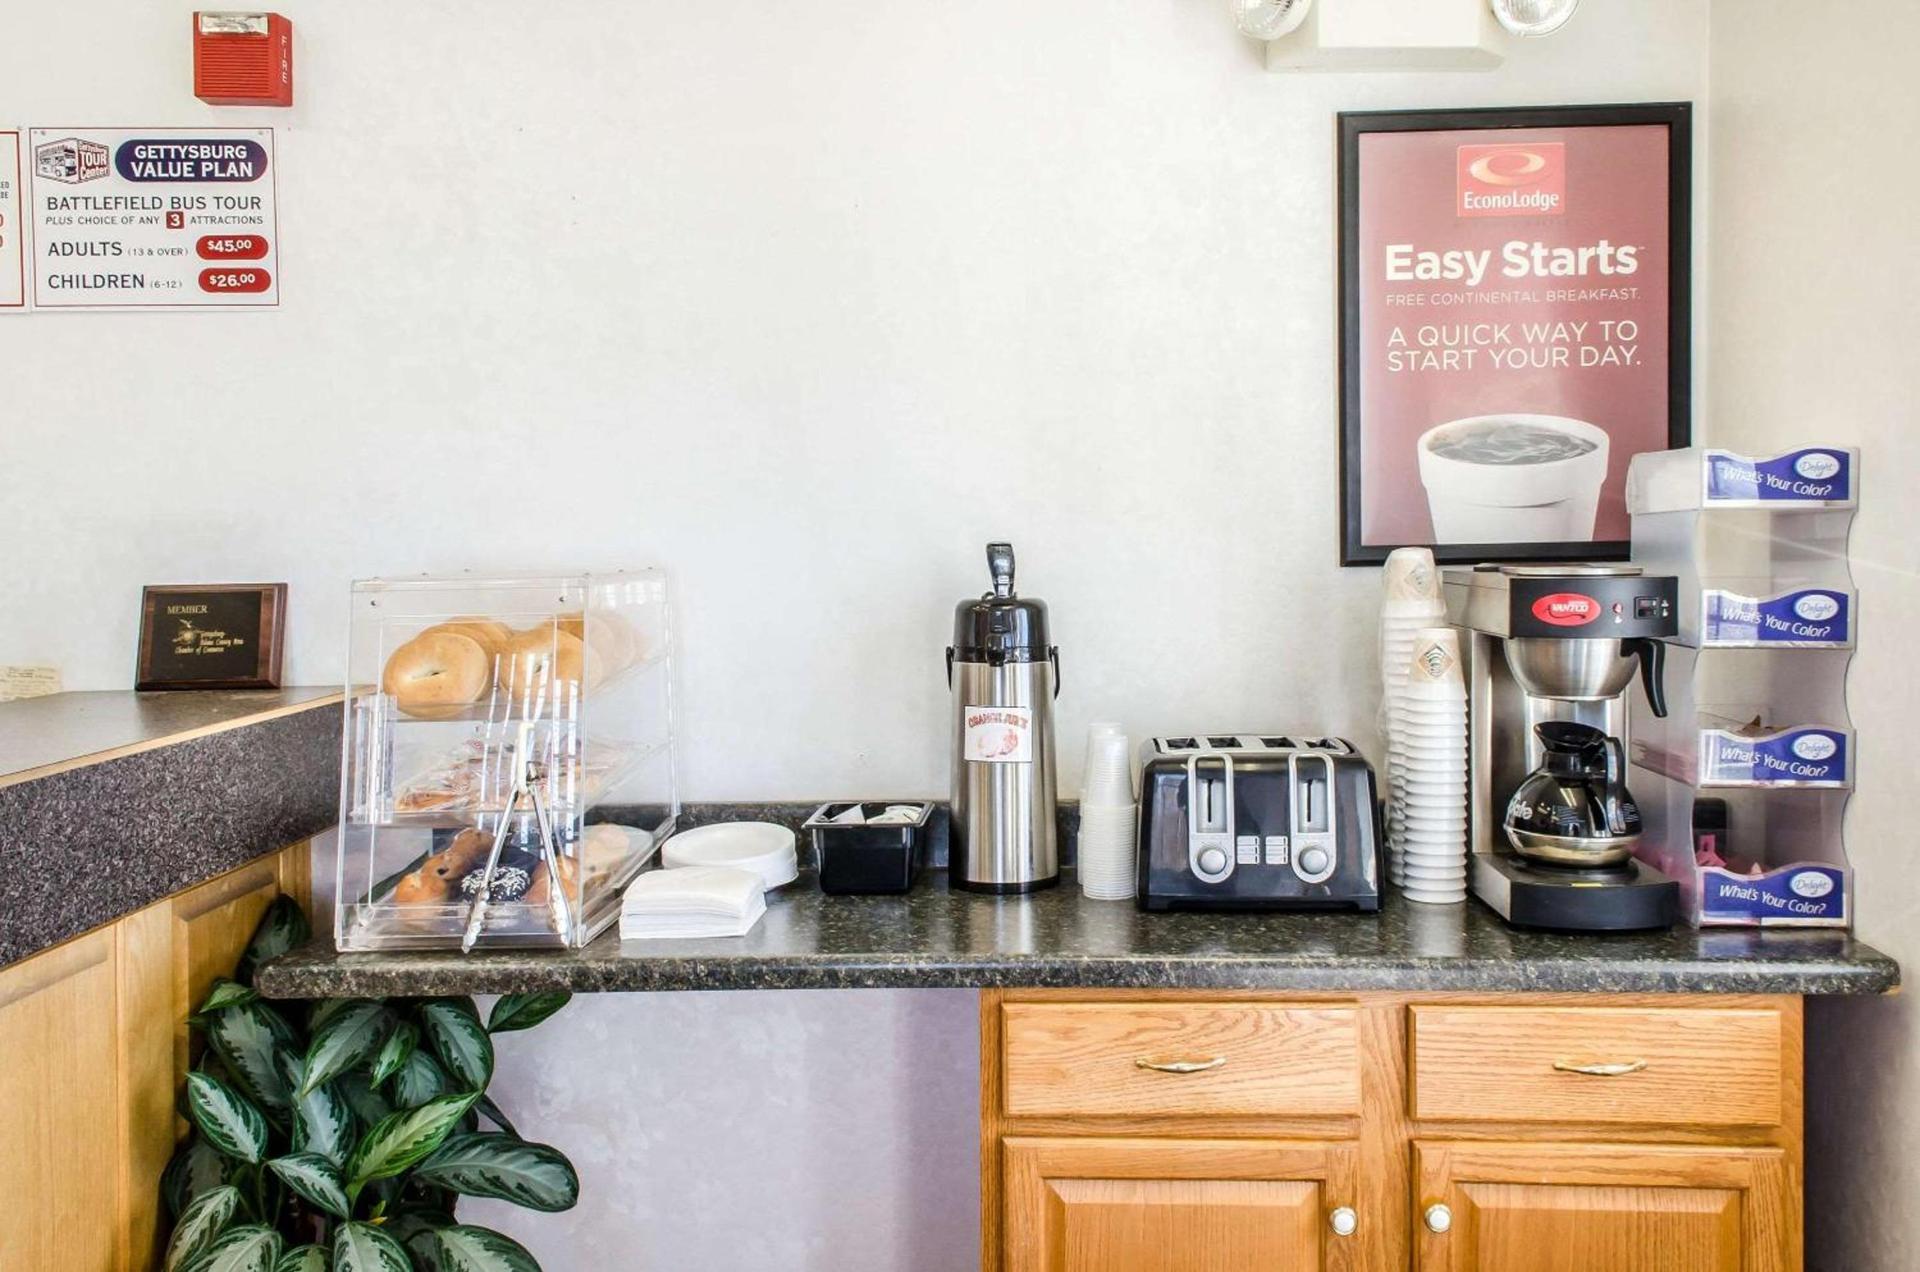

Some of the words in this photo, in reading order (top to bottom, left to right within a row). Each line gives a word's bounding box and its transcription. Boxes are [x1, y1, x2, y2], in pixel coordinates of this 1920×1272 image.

[80, 149, 107, 167] TOUR
[134, 145, 247, 160] GETTYSBURG
[130, 162, 196, 178] VALUE
[201, 162, 253, 178] PLAN
[47, 196, 163, 210] BATTLEFIELD
[170, 196, 207, 210] BUS
[213, 196, 262, 210] TOUR
[1464, 190, 1560, 211] EconoLodge
[45, 216, 73, 225] PLUS
[77, 216, 117, 225] CHOICE
[121, 216, 135, 225] OF
[138, 216, 161, 225] ANY
[170, 213, 181, 227] 3
[190, 215, 264, 225] ATTRACTIONS
[48, 241, 123, 257] ADULTS
[157, 247, 189, 256] OVER)
[207, 239, 252, 253] $45.00
[1385, 243, 1492, 286] Easy
[48, 274, 145, 289] CHILDREN
[150, 280, 183, 289] (6-12)
[209, 273, 256, 288] $26.00
[1386, 294, 1425, 306] FREE
[1430, 291, 1539, 306] CONTINENTAL
[1546, 288, 1641, 302] BREAKFAST.
[1387, 327, 1407, 347] A
[1418, 323, 1513, 347] QUICK
[1522, 321, 1589, 344] WAY
[1599, 320, 1638, 342] TO
[1388, 348, 1478, 372] START
[1489, 346, 1569, 369] YOUR
[1580, 345, 1641, 368] DAY.
[1722, 466, 1763, 484] What's
[1766, 473, 1792, 491] Your
[1793, 481, 1832, 496] Color?
[167, 605, 208, 615] MEMBER
[1722, 607, 1763, 624] What's
[1765, 614, 1791, 632] Your
[1792, 621, 1831, 638] Color?
[1720, 747, 1761, 765] What's
[1763, 754, 1789, 771] Your
[1789, 761, 1829, 777] Color?
[1719, 884, 1759, 901] What's
[1761, 891, 1787, 909] Your
[1788, 899, 1827, 914] Color?
